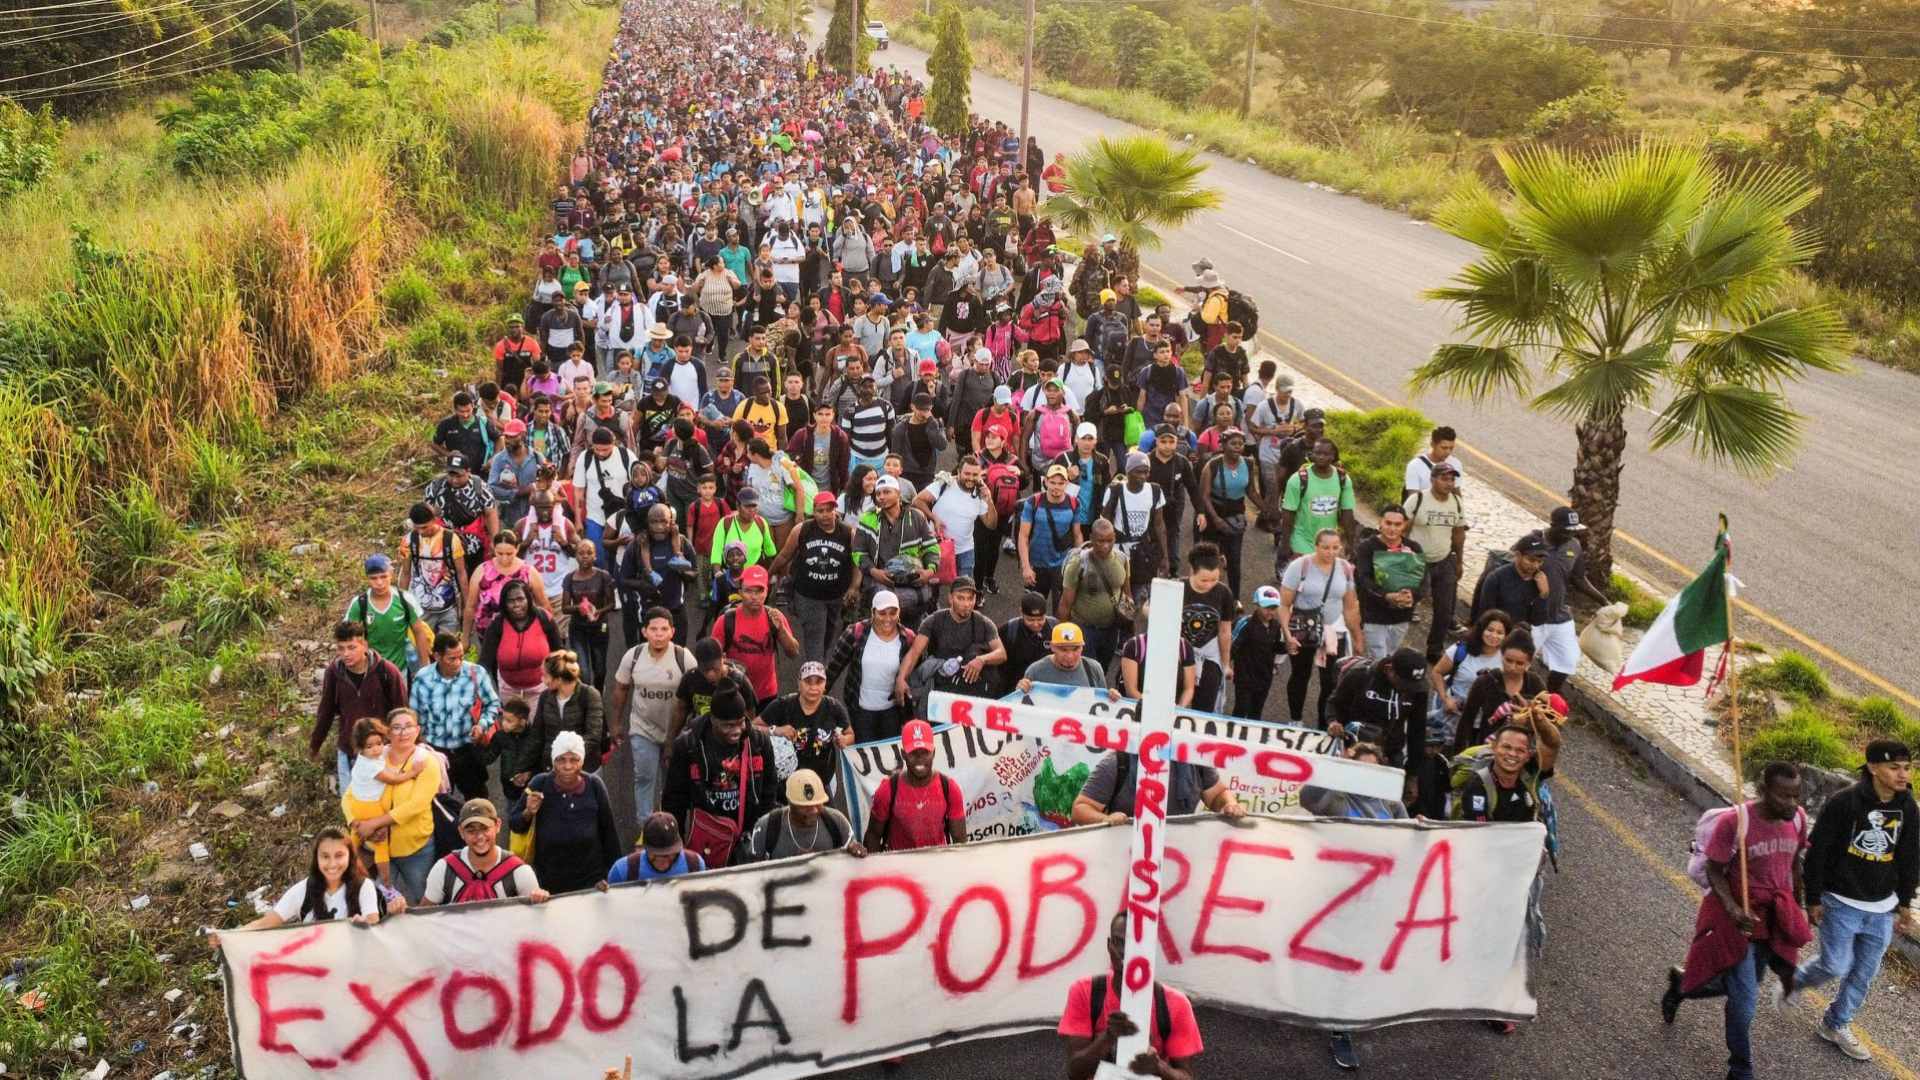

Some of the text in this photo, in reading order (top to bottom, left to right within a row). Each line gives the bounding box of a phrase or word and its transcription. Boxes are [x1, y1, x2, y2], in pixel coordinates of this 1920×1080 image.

[534, 554, 556, 573] 23
[640, 688, 674, 701] Jeep
[1125, 731, 1170, 993] CRISTO
[250, 839, 1460, 1080] ÉXODO DE LA POBREZA
